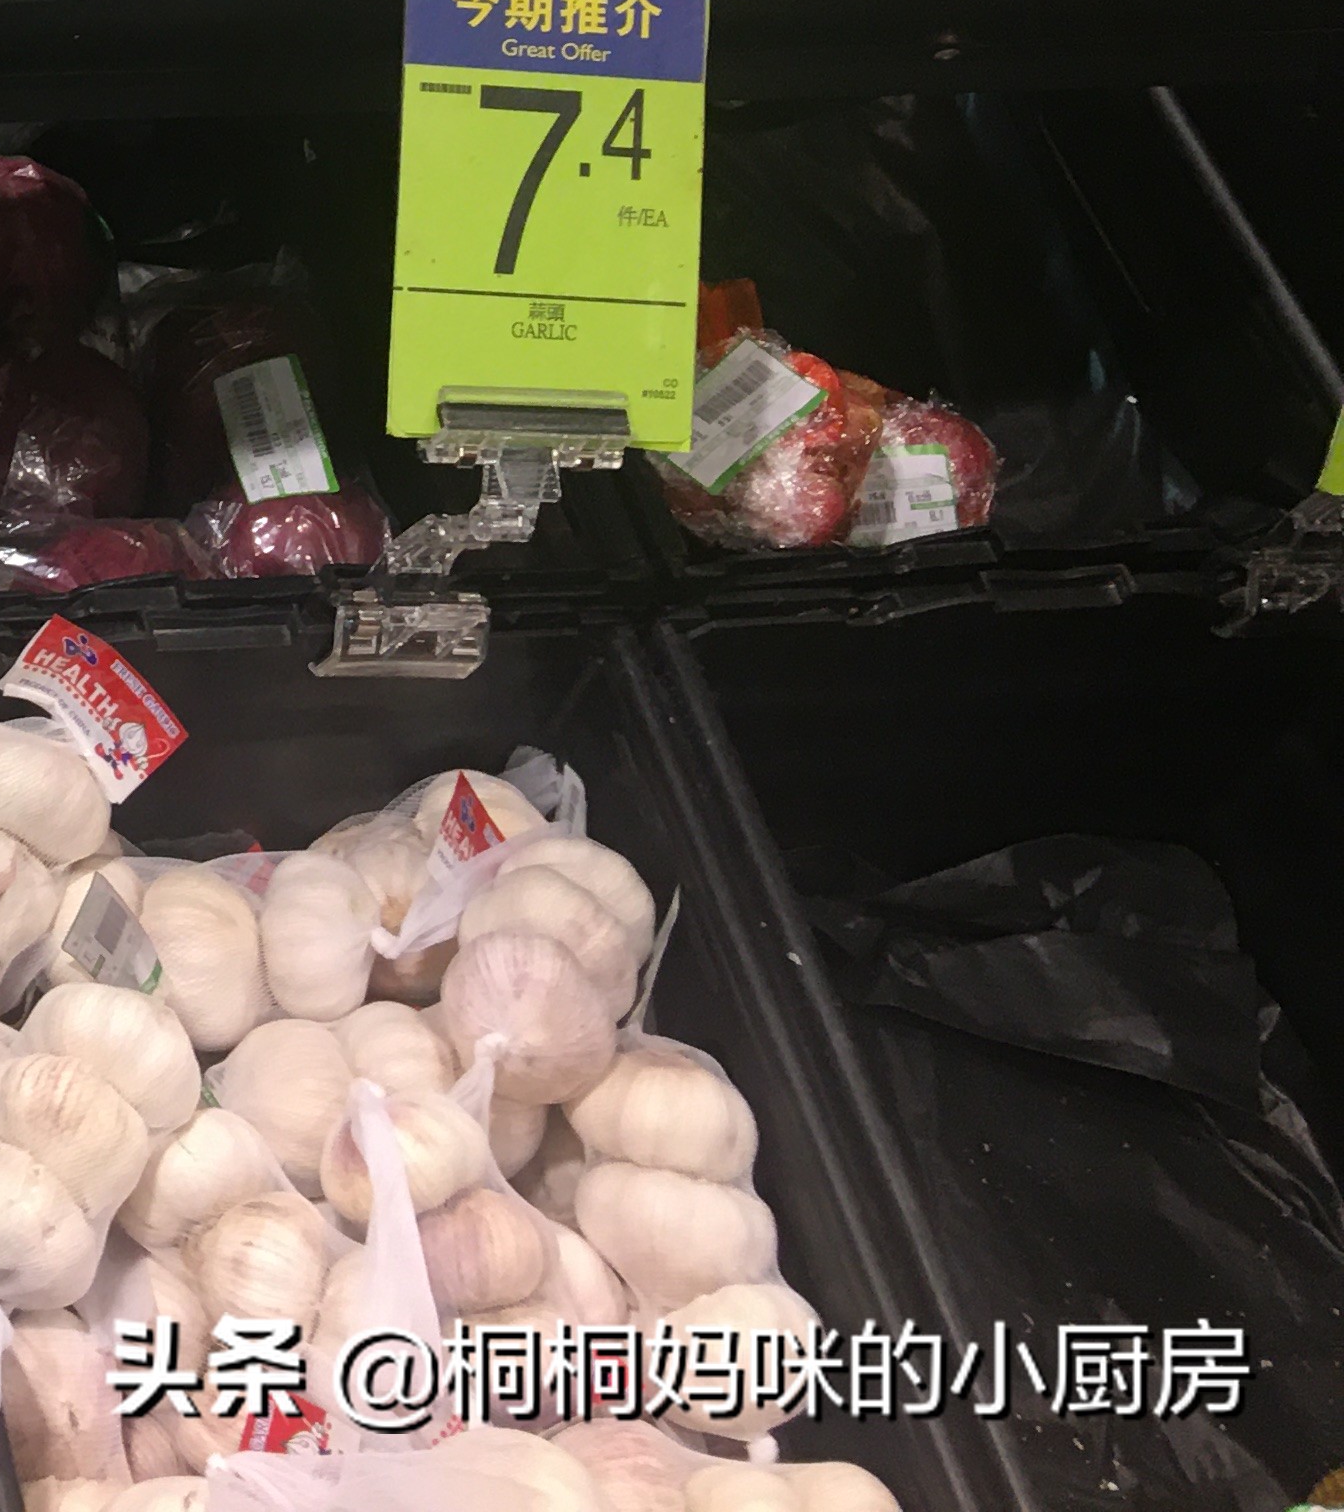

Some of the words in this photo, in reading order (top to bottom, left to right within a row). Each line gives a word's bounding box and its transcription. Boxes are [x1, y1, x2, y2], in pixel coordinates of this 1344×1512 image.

[502, 38, 556, 61] Great
[561, 41, 612, 63] Offer
[479, 85, 652, 275] 7.4
[617, 204, 669, 228] 件/EA
[528, 301, 566, 322] 蒜頭
[511, 320, 578, 341] GARLIC
